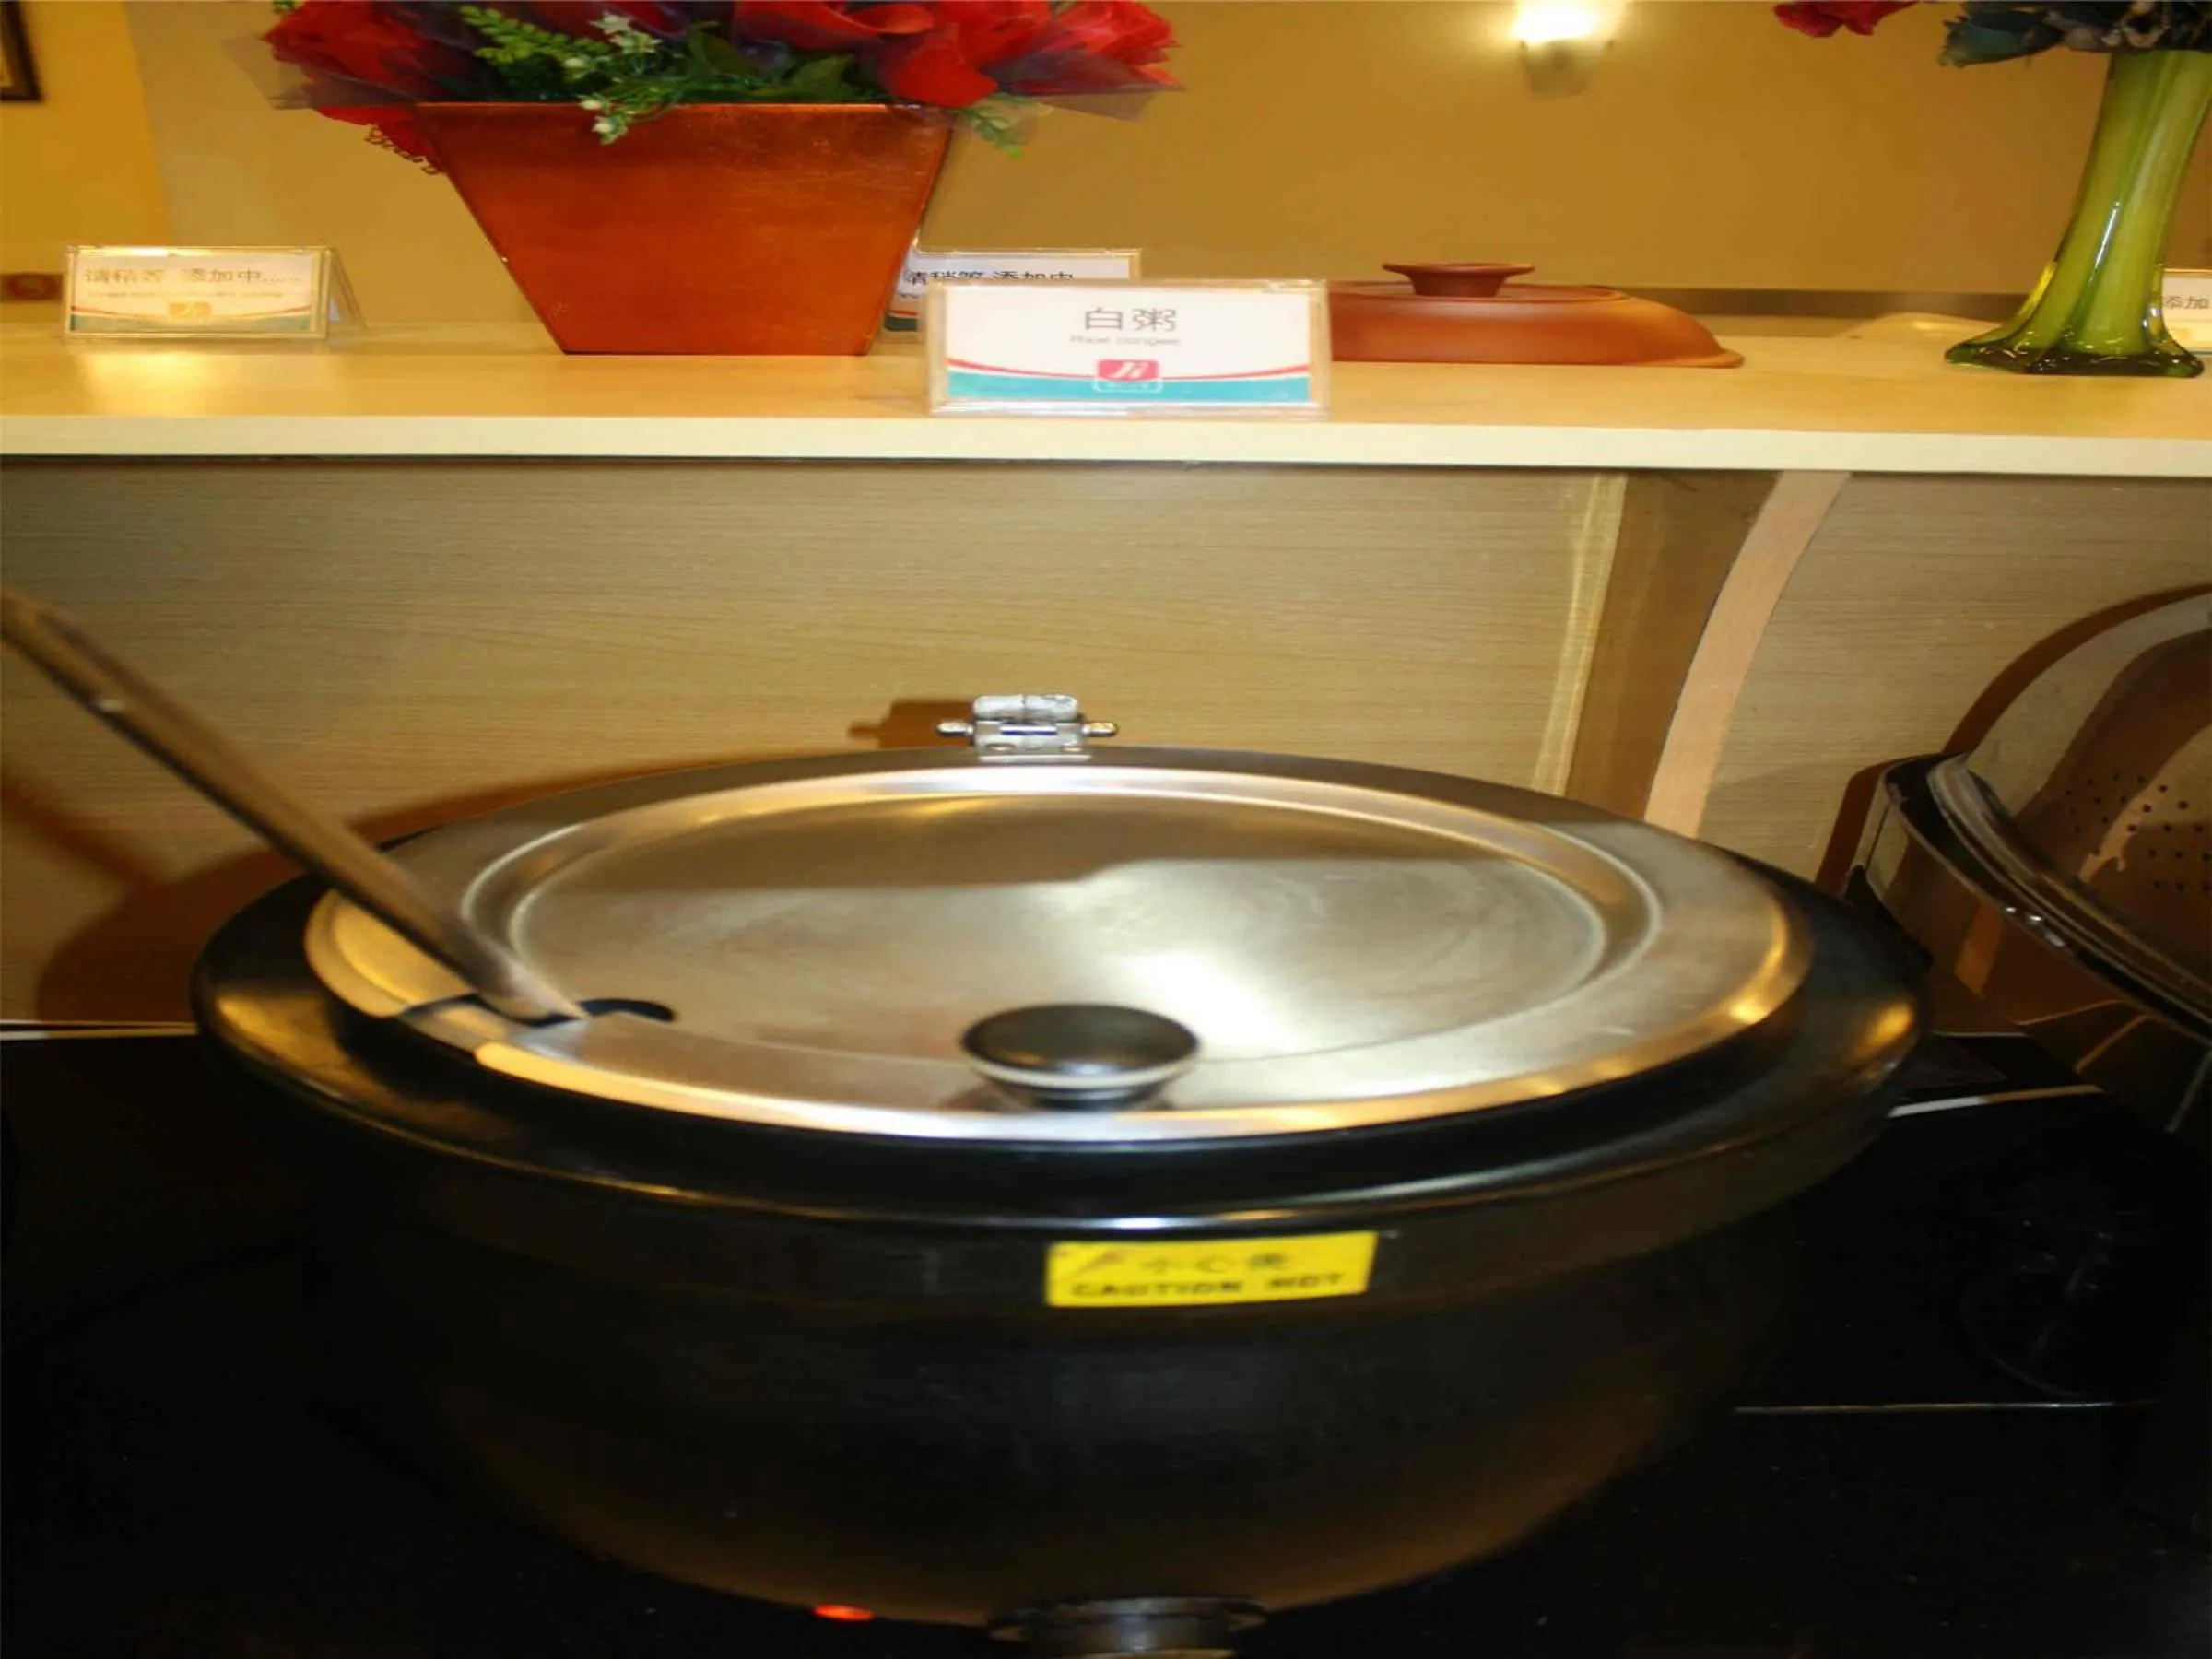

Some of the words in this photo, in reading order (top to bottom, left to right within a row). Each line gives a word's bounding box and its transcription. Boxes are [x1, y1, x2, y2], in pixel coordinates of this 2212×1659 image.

[1084, 307, 1177, 333] 白粥
[1071, 1279, 1243, 1298] CAUTION
[1267, 1272, 1344, 1290] HOT
